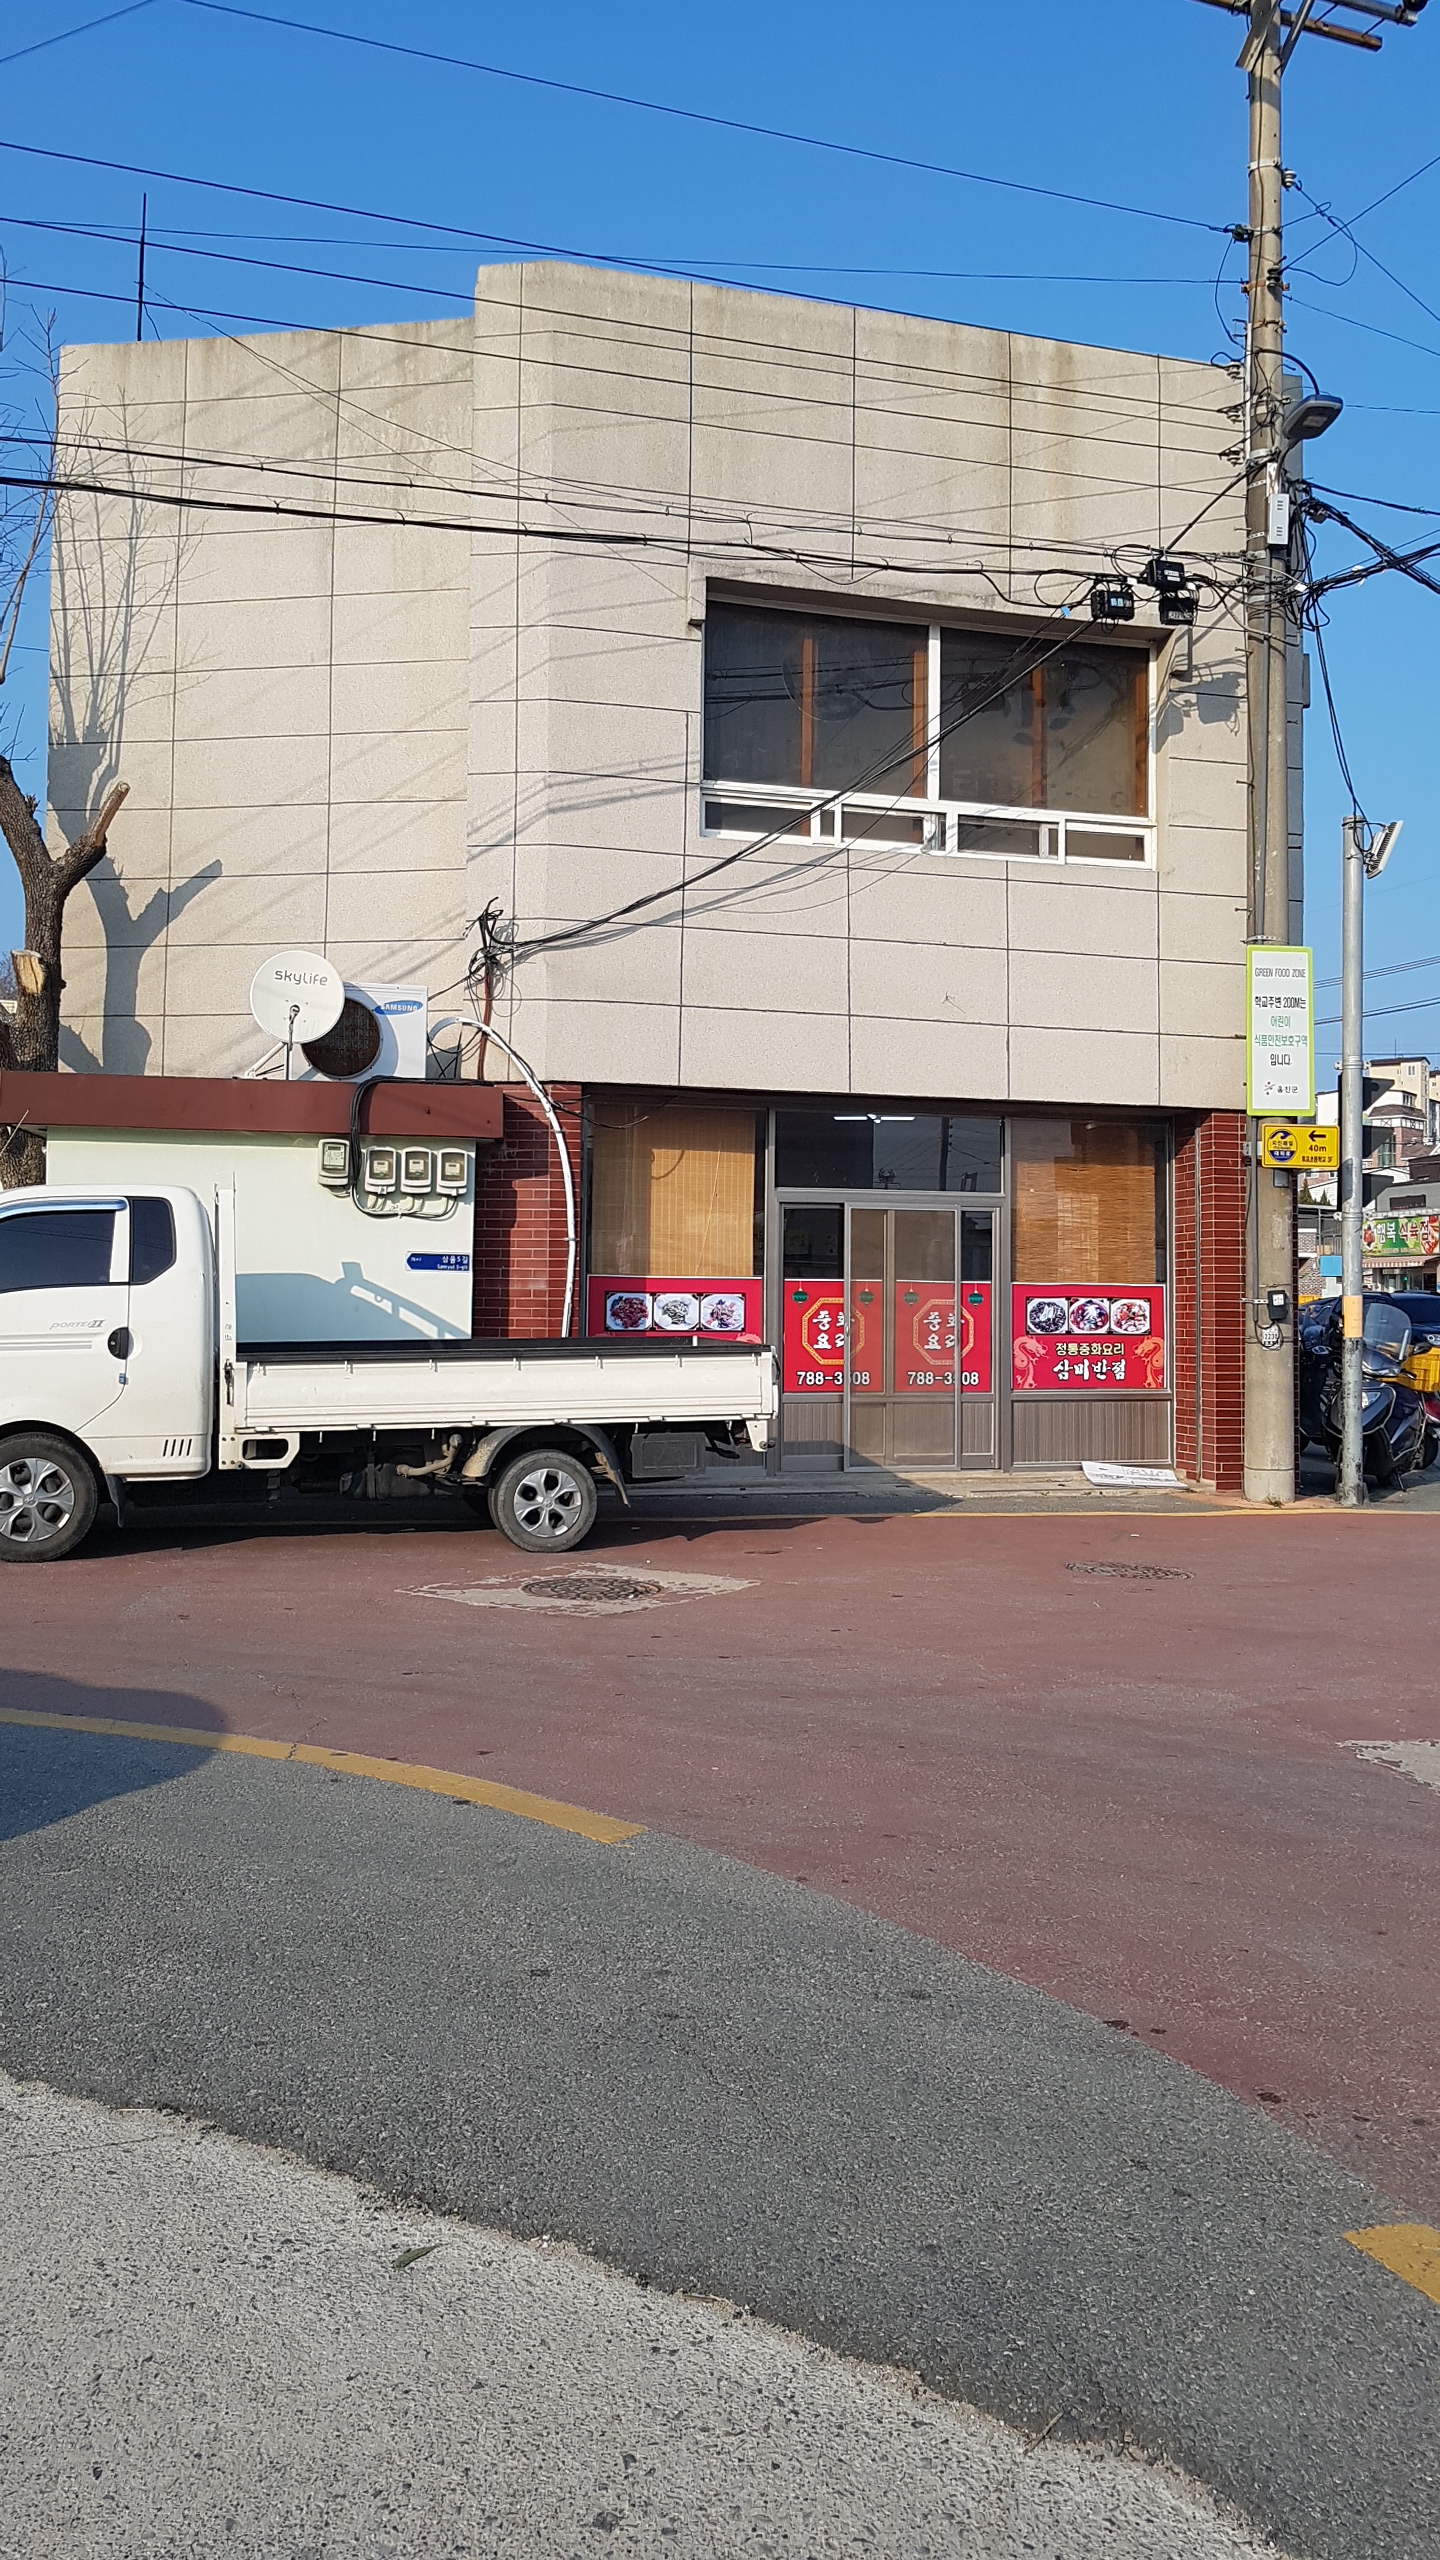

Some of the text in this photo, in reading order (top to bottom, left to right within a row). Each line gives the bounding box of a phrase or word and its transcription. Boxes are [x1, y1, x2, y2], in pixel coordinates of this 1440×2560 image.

[1254, 967, 1306, 978] GREEN FOOD ZONE
[380, 1003, 418, 1012] SAMSUNG
[1254, 995, 1282, 1009] 학교주변
[1270, 1015, 1291, 1028] 어린이
[1253, 1034, 1308, 1047] 식품안전보호구역
[1308, 1144, 1327, 1152] 40m
[1376, 1220, 1429, 1244] 행복 식육점
[1055, 1342, 1124, 1356] 정통중화요리
[1052, 1358, 1126, 1380] 삼미반점
[796, 1371, 870, 1385] 788-308
[907, 1371, 979, 1385] 788-308
